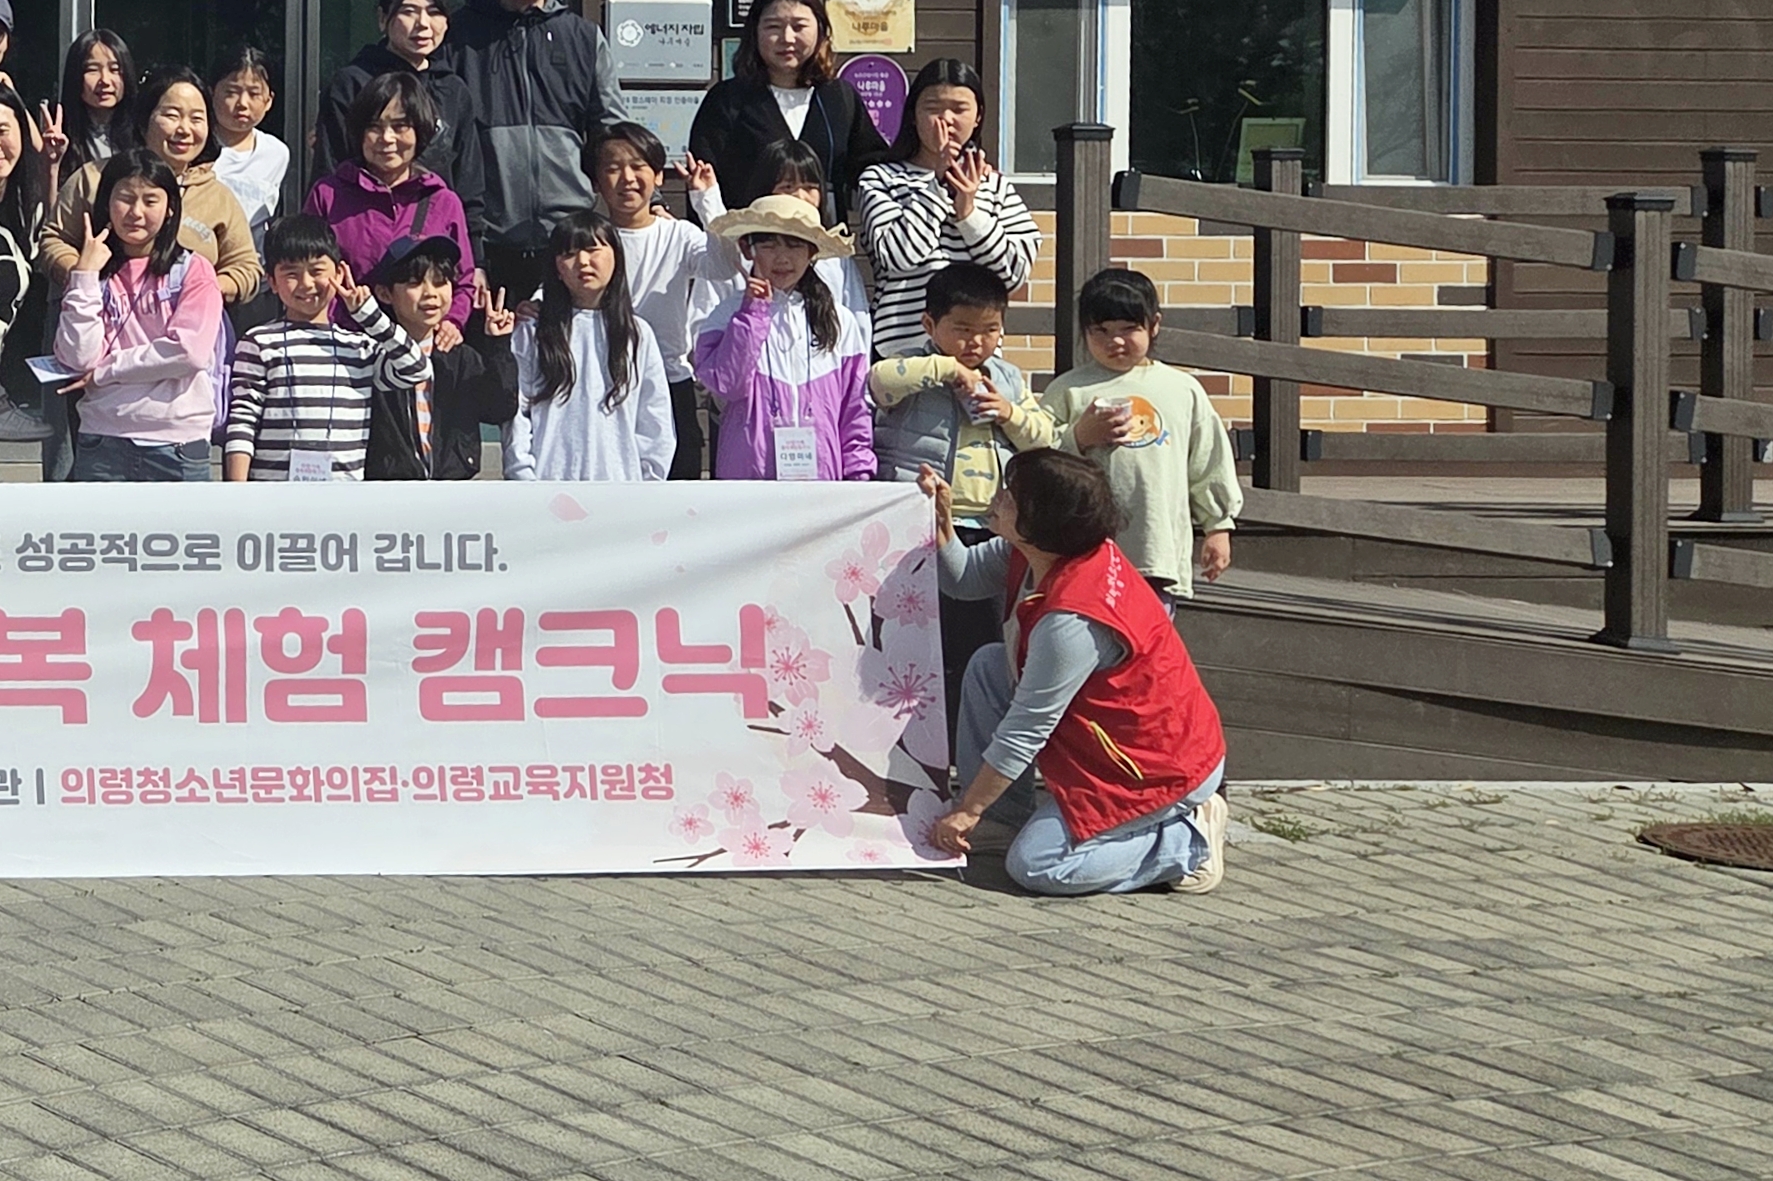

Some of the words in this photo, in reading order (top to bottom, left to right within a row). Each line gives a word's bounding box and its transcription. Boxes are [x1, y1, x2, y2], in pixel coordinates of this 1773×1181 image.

[644, 23, 679, 35] 에너지
[681, 23, 705, 35] 자립
[15, 532, 222, 573] 성공적으로
[236, 532, 359, 573] 이끌어
[373, 532, 508, 573] 갑니다.
[132, 607, 366, 723] 체험
[412, 604, 768, 720] 캠크닉
[61, 763, 674, 804] 의령청소년문화의집·의령교육지원청
